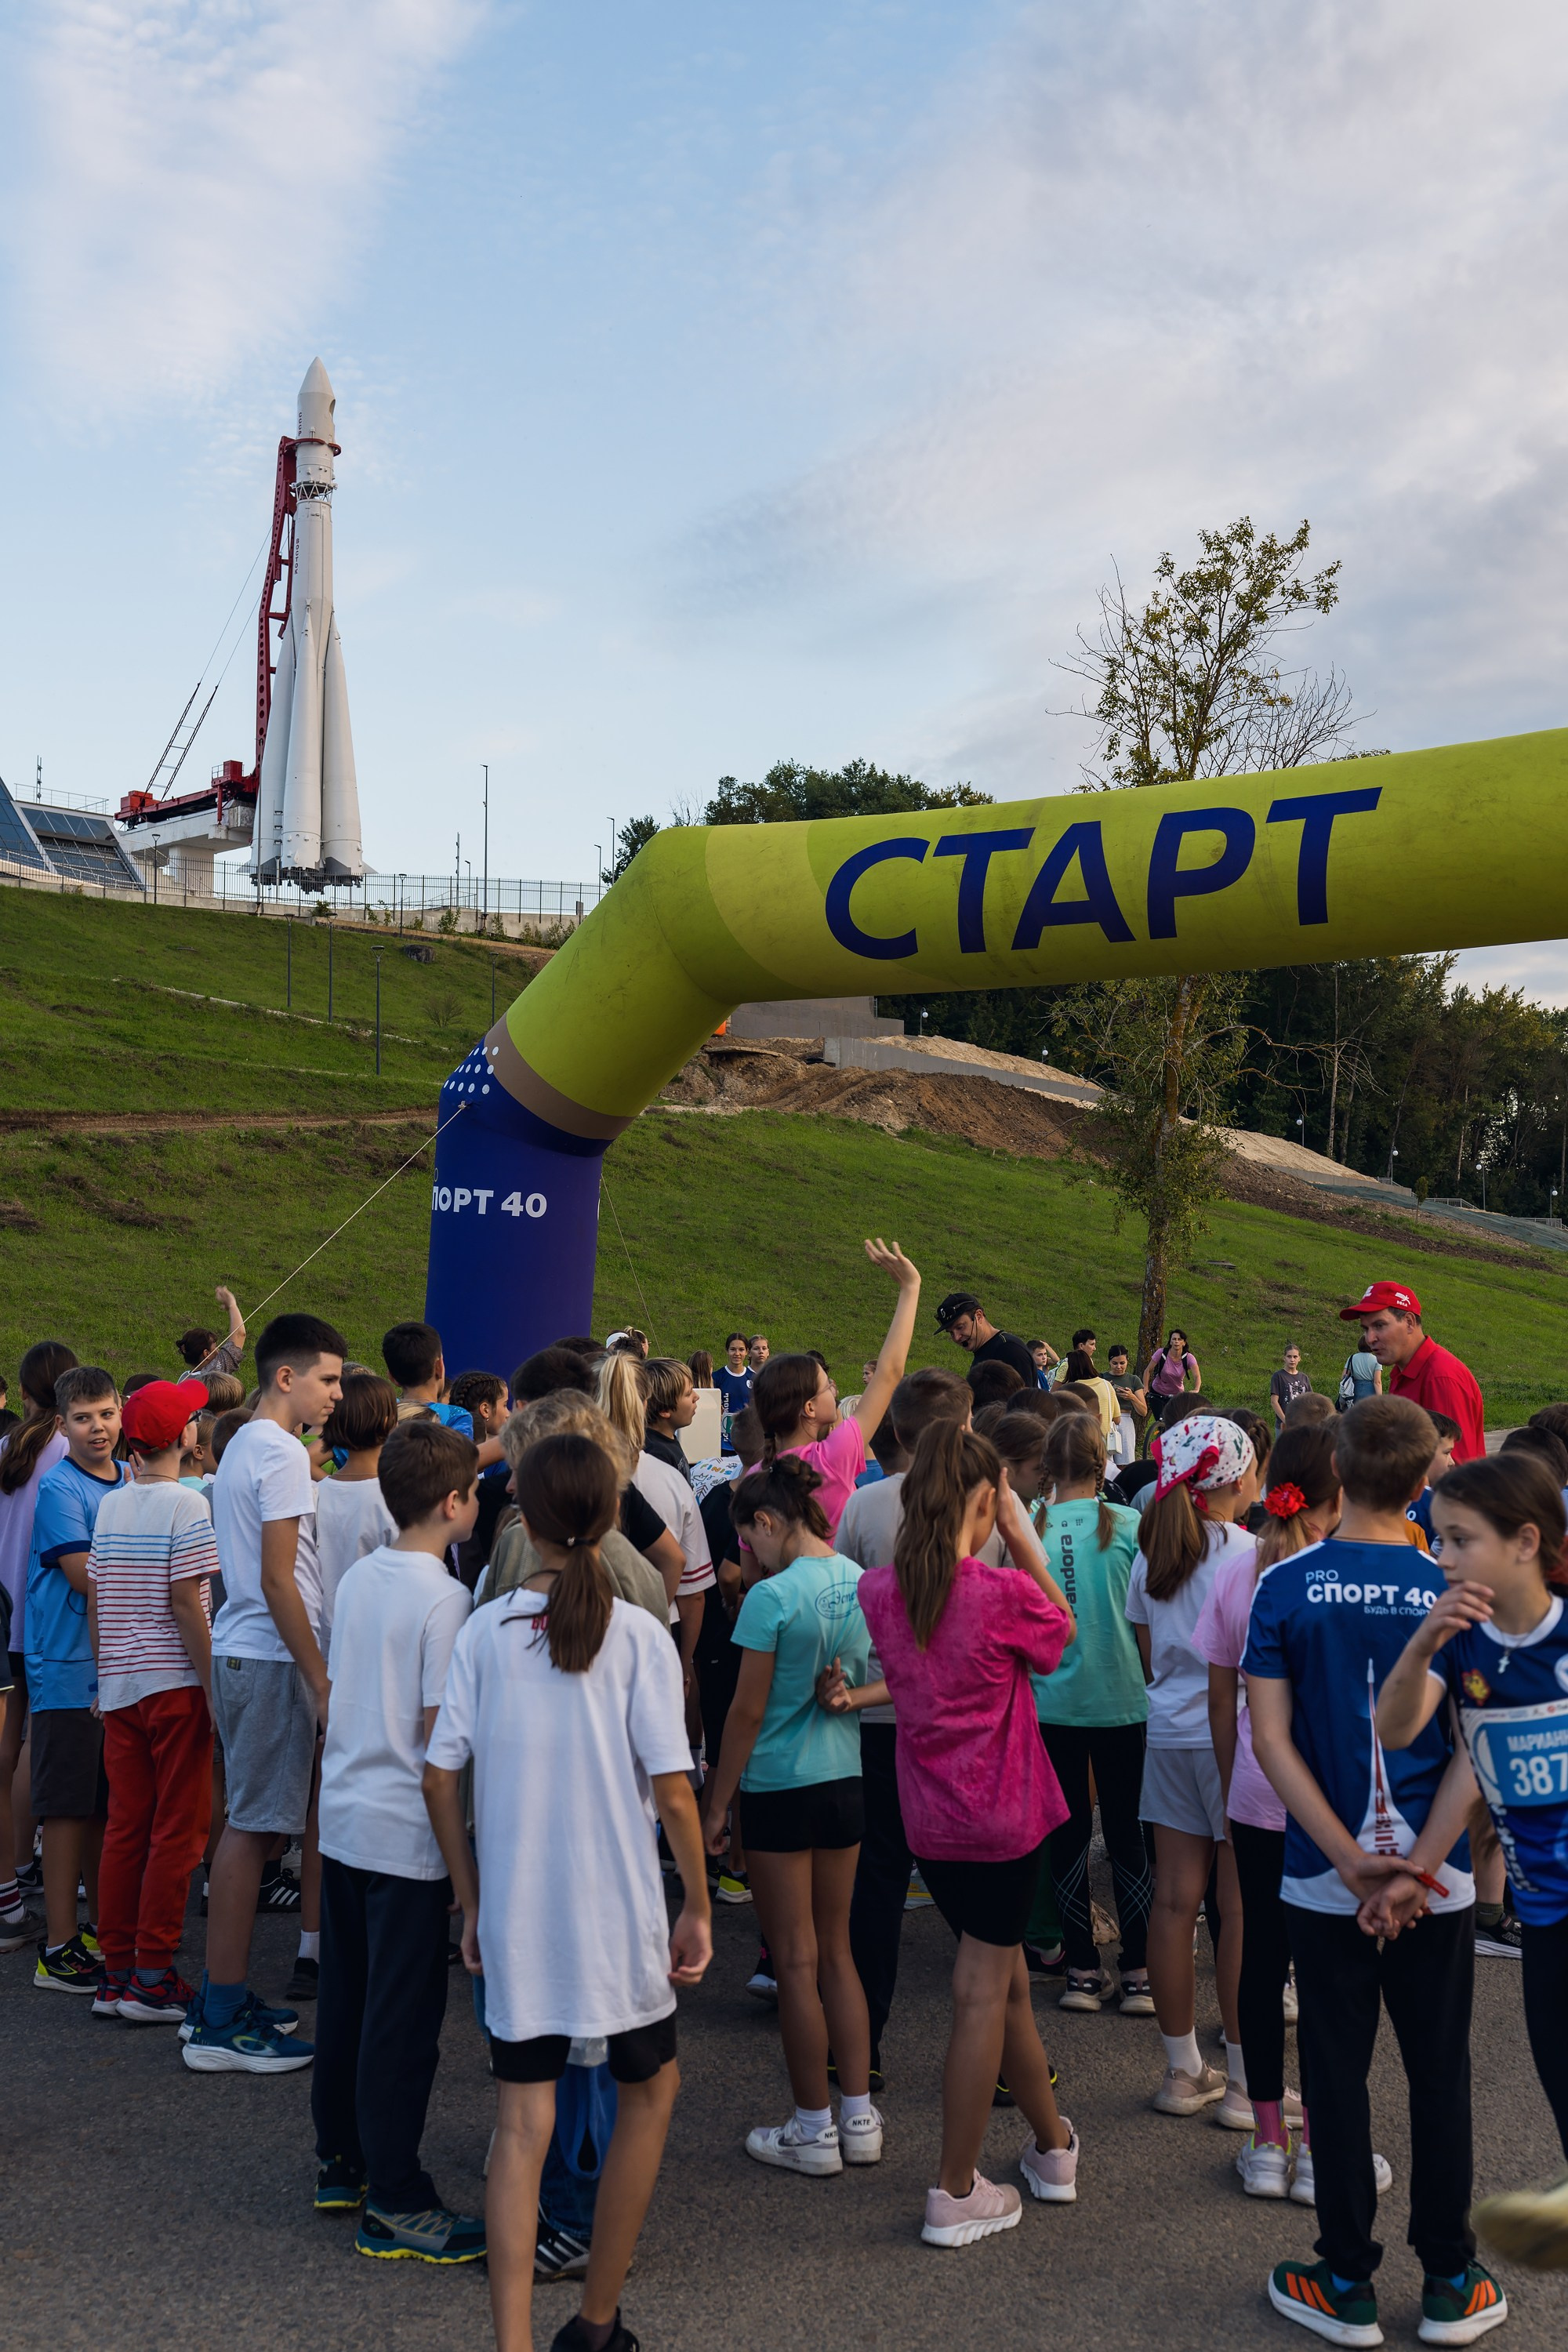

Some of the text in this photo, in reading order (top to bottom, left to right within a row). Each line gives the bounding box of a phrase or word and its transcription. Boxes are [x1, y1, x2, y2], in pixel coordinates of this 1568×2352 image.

[826, 786, 1382, 960] СТАРТ
[501, 1191, 547, 1218] 40
[1060, 1534, 1078, 1619] andora
[1305, 1569, 1339, 1584] PRO
[1306, 1582, 1438, 1610] СПОРТ 40
[1363, 1605, 1389, 1615] БУДЬ
[1390, 1606, 1398, 1615] В
[1509, 1751, 1568, 1797] 387
[824, 2131, 838, 2140] NKT
